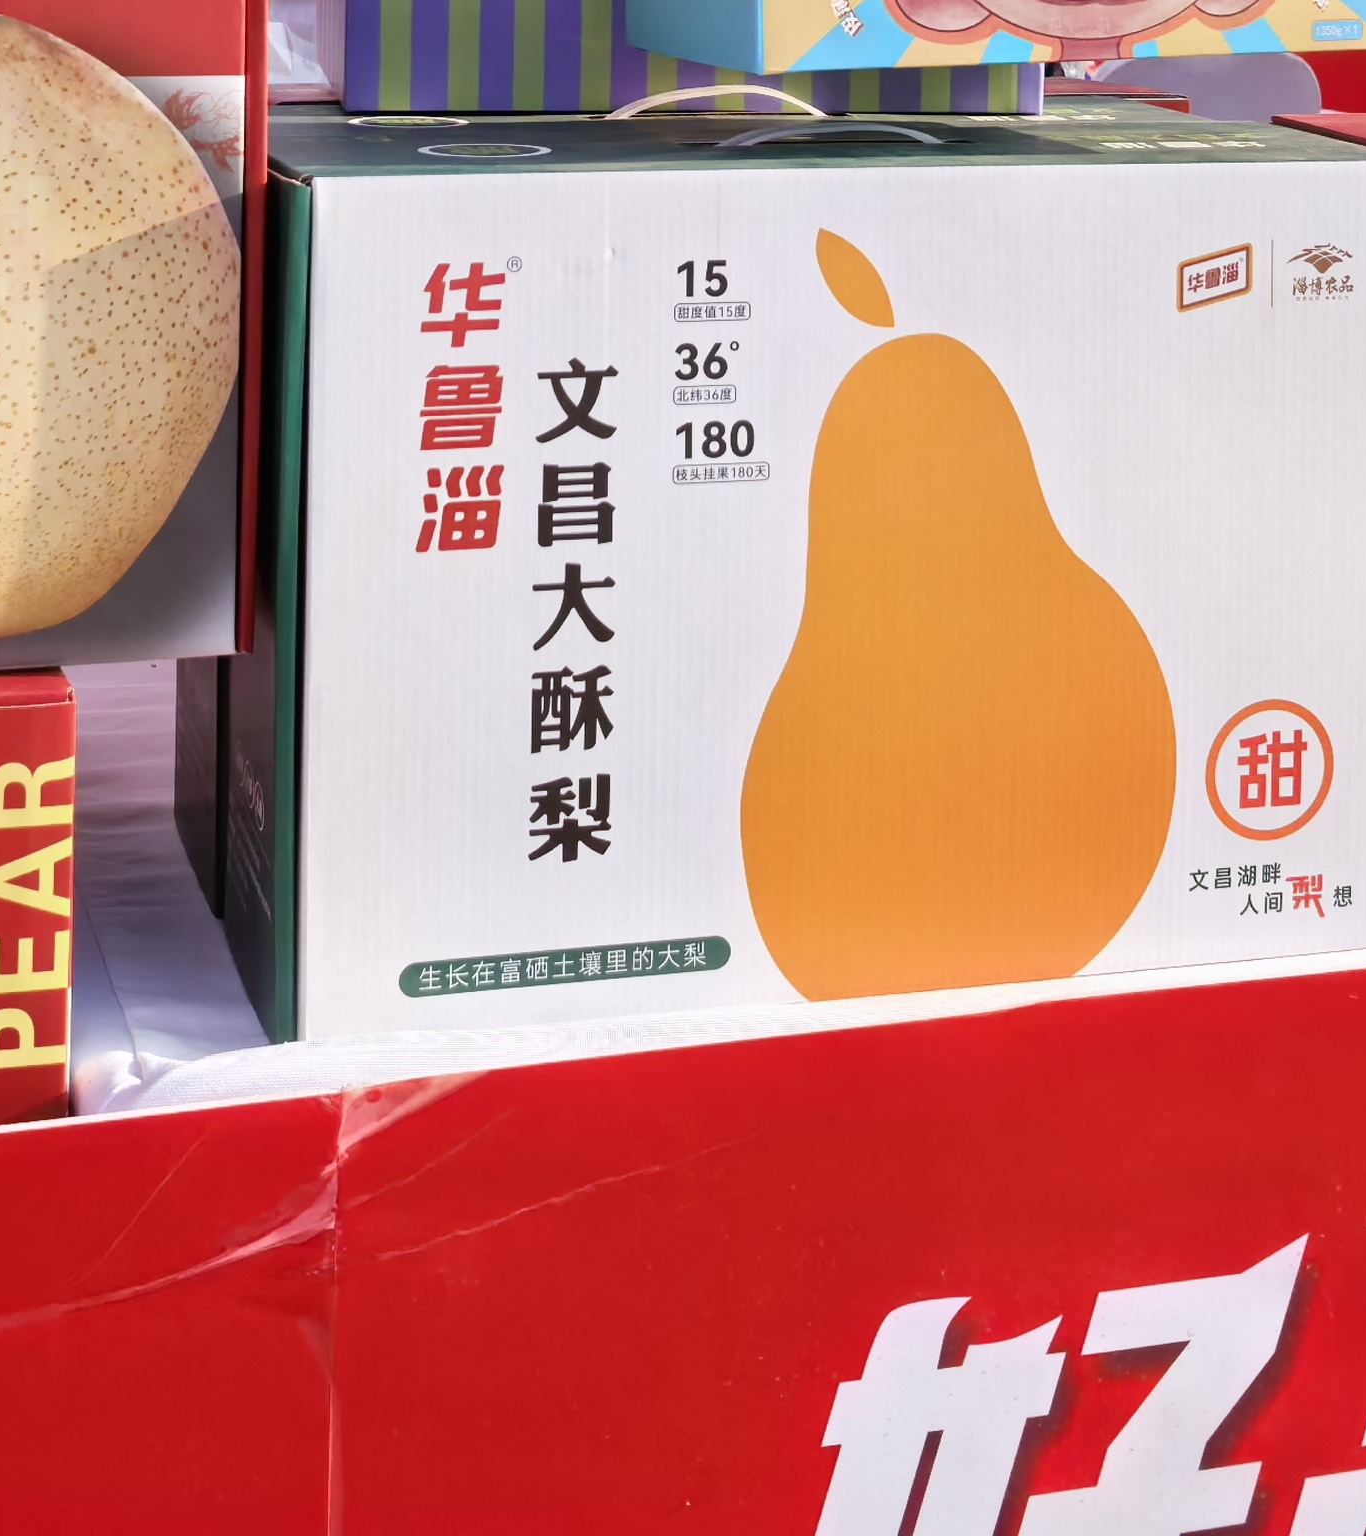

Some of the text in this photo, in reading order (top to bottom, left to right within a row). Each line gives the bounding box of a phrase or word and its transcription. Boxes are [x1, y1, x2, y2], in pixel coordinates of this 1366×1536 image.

[677, 259, 729, 298] 15
[1291, 275, 1354, 296] 淄博农品
[677, 304, 747, 320] 甜度值15度
[674, 340, 740, 381] 36°
[415, 261, 507, 554] 华鲁淄
[676, 387, 733, 402] 北纬36度
[675, 419, 755, 460] 180
[675, 464, 767, 482] 枝头挂果180天
[526, 357, 619, 863] 文昌大酥梨
[1237, 729, 1308, 809] 甜
[1189, 862, 1281, 892] 文昌湖畔
[418, 940, 707, 993] 生长在富硒土壤里的大梨
